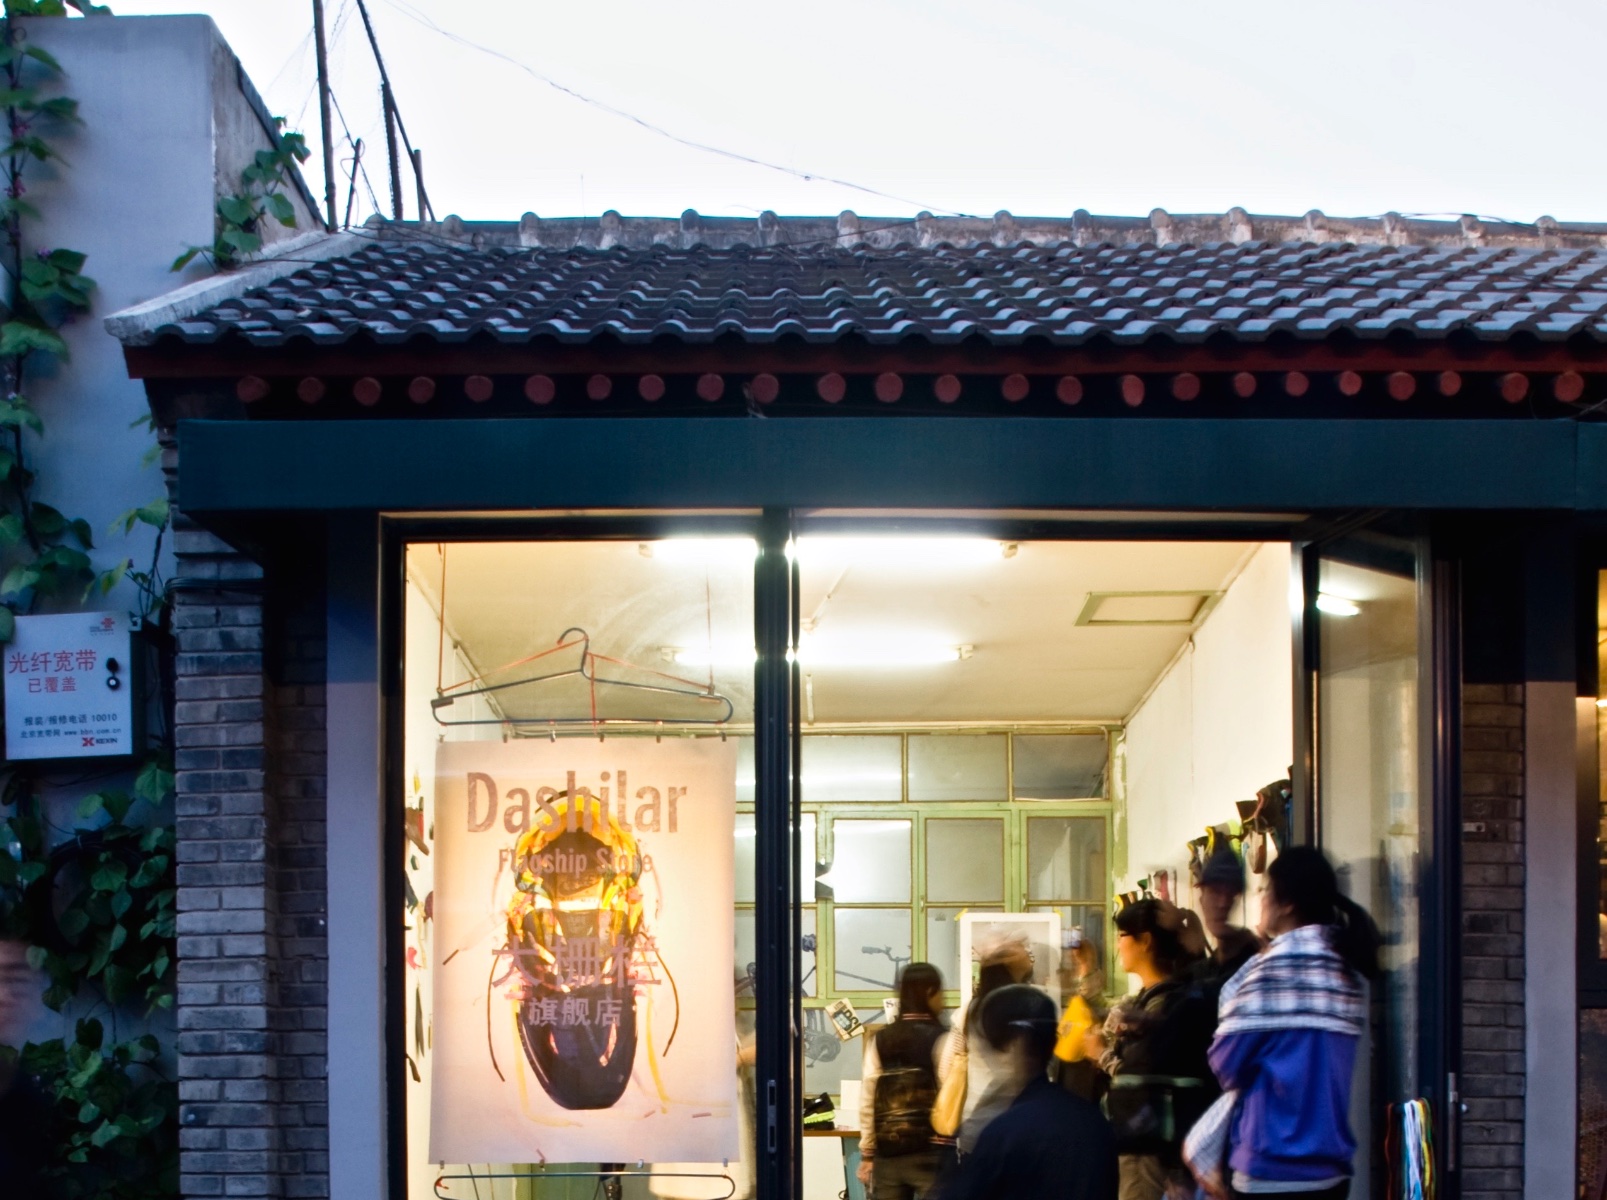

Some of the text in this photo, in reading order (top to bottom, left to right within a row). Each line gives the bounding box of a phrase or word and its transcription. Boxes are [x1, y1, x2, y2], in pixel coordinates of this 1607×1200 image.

[9, 650, 97, 674] 光纤宽带
[28, 676, 77, 693] 已覆盖
[91, 713, 118, 722] 10010
[466, 770, 688, 834] Dashilar
[498, 848, 653, 878] Flagship Store
[492, 934, 662, 988] 大栅栏
[529, 996, 623, 1027] 旗舰店
